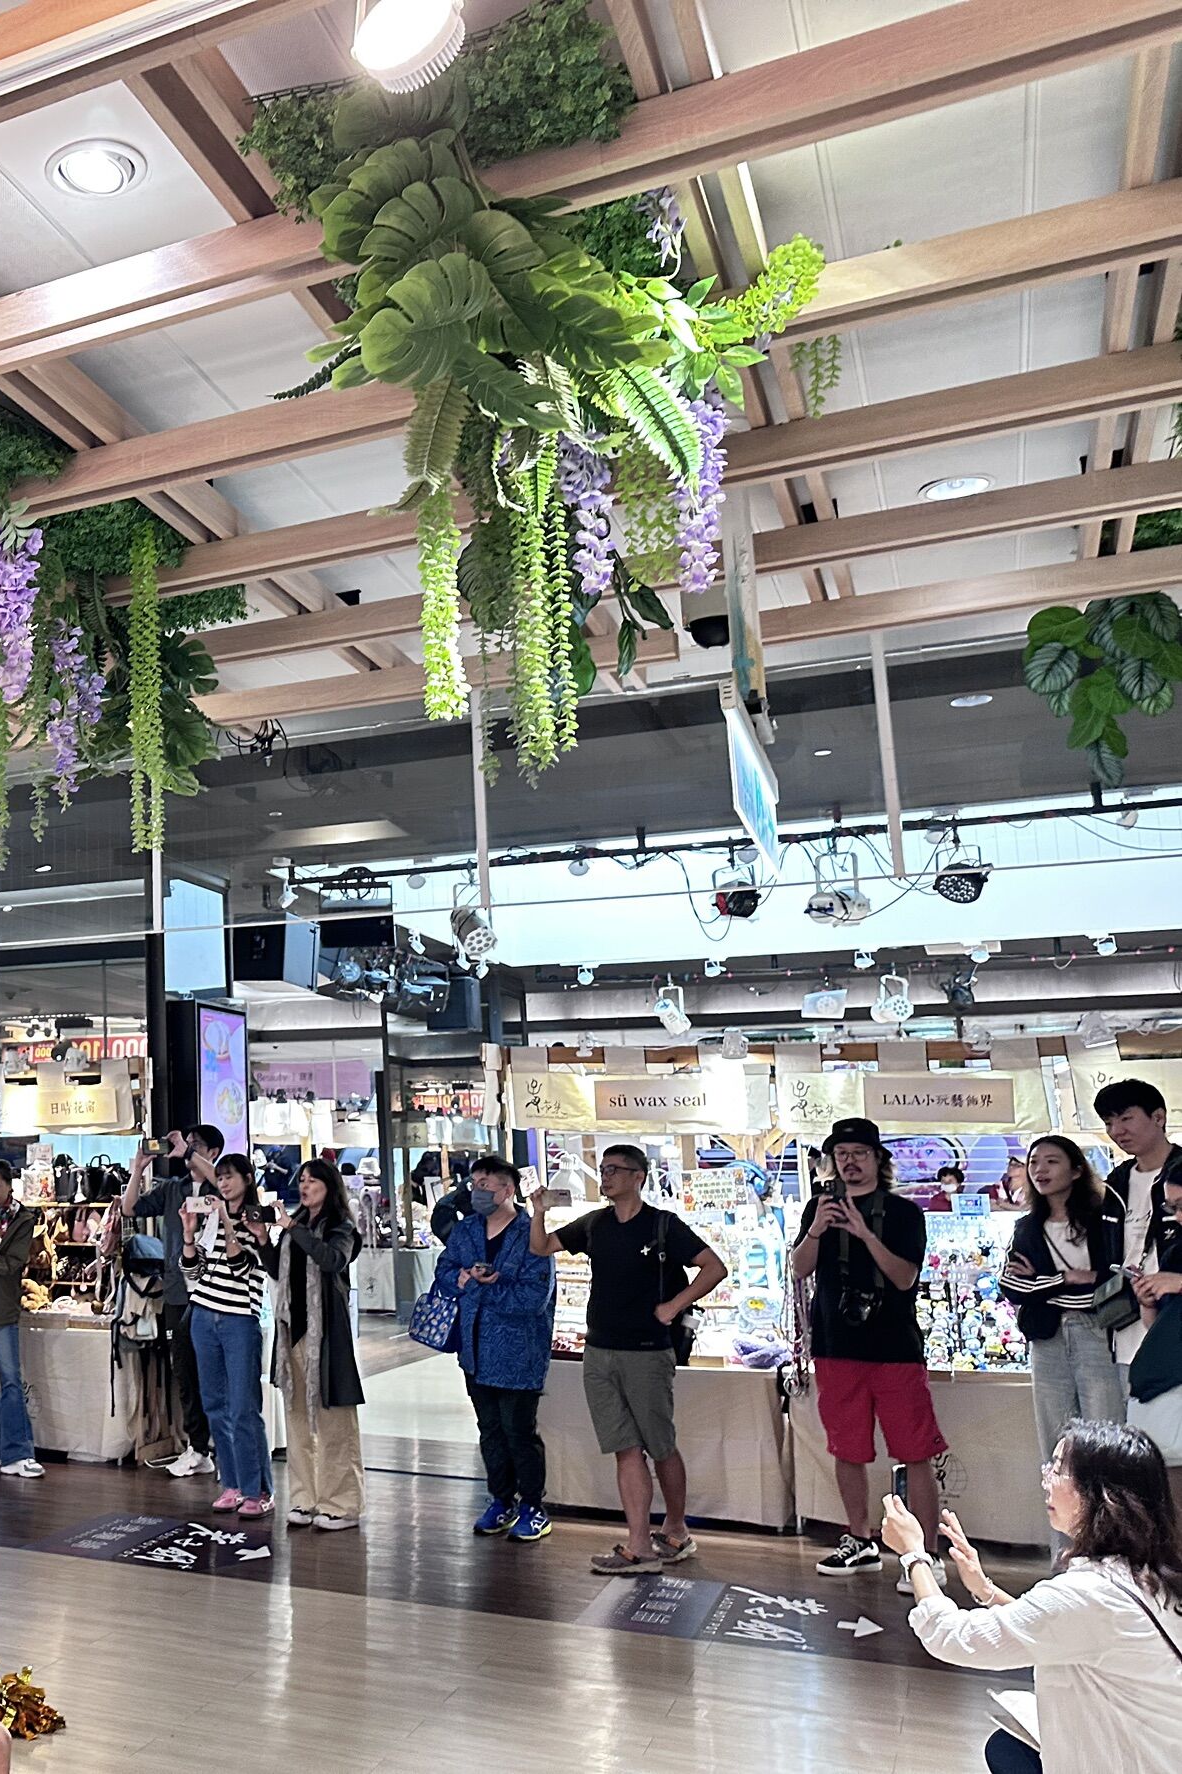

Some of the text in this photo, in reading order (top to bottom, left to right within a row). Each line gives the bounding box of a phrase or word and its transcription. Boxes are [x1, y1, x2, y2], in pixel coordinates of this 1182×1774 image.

[609, 1092, 706, 1108] sü wax seal
